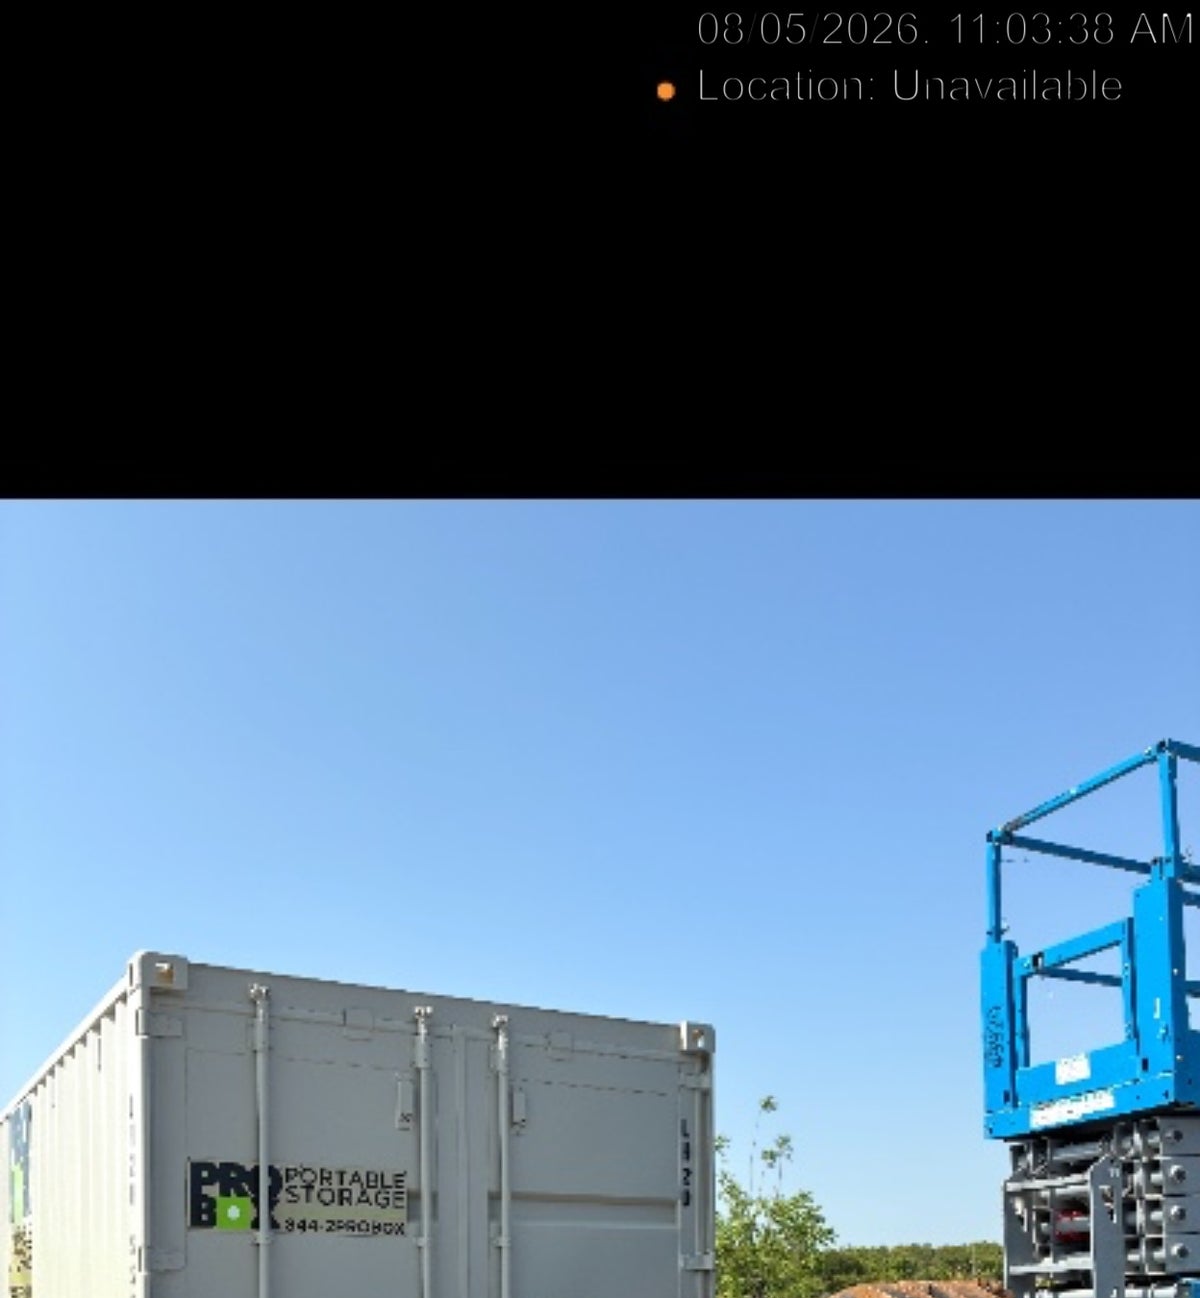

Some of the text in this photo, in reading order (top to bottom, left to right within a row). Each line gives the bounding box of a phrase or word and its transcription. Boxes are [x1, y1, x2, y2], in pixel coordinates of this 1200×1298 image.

[190, 1162, 284, 1199] PRO
[284, 1167, 407, 1190] PORTABLE
[284, 1184, 406, 1209] STORAGE
